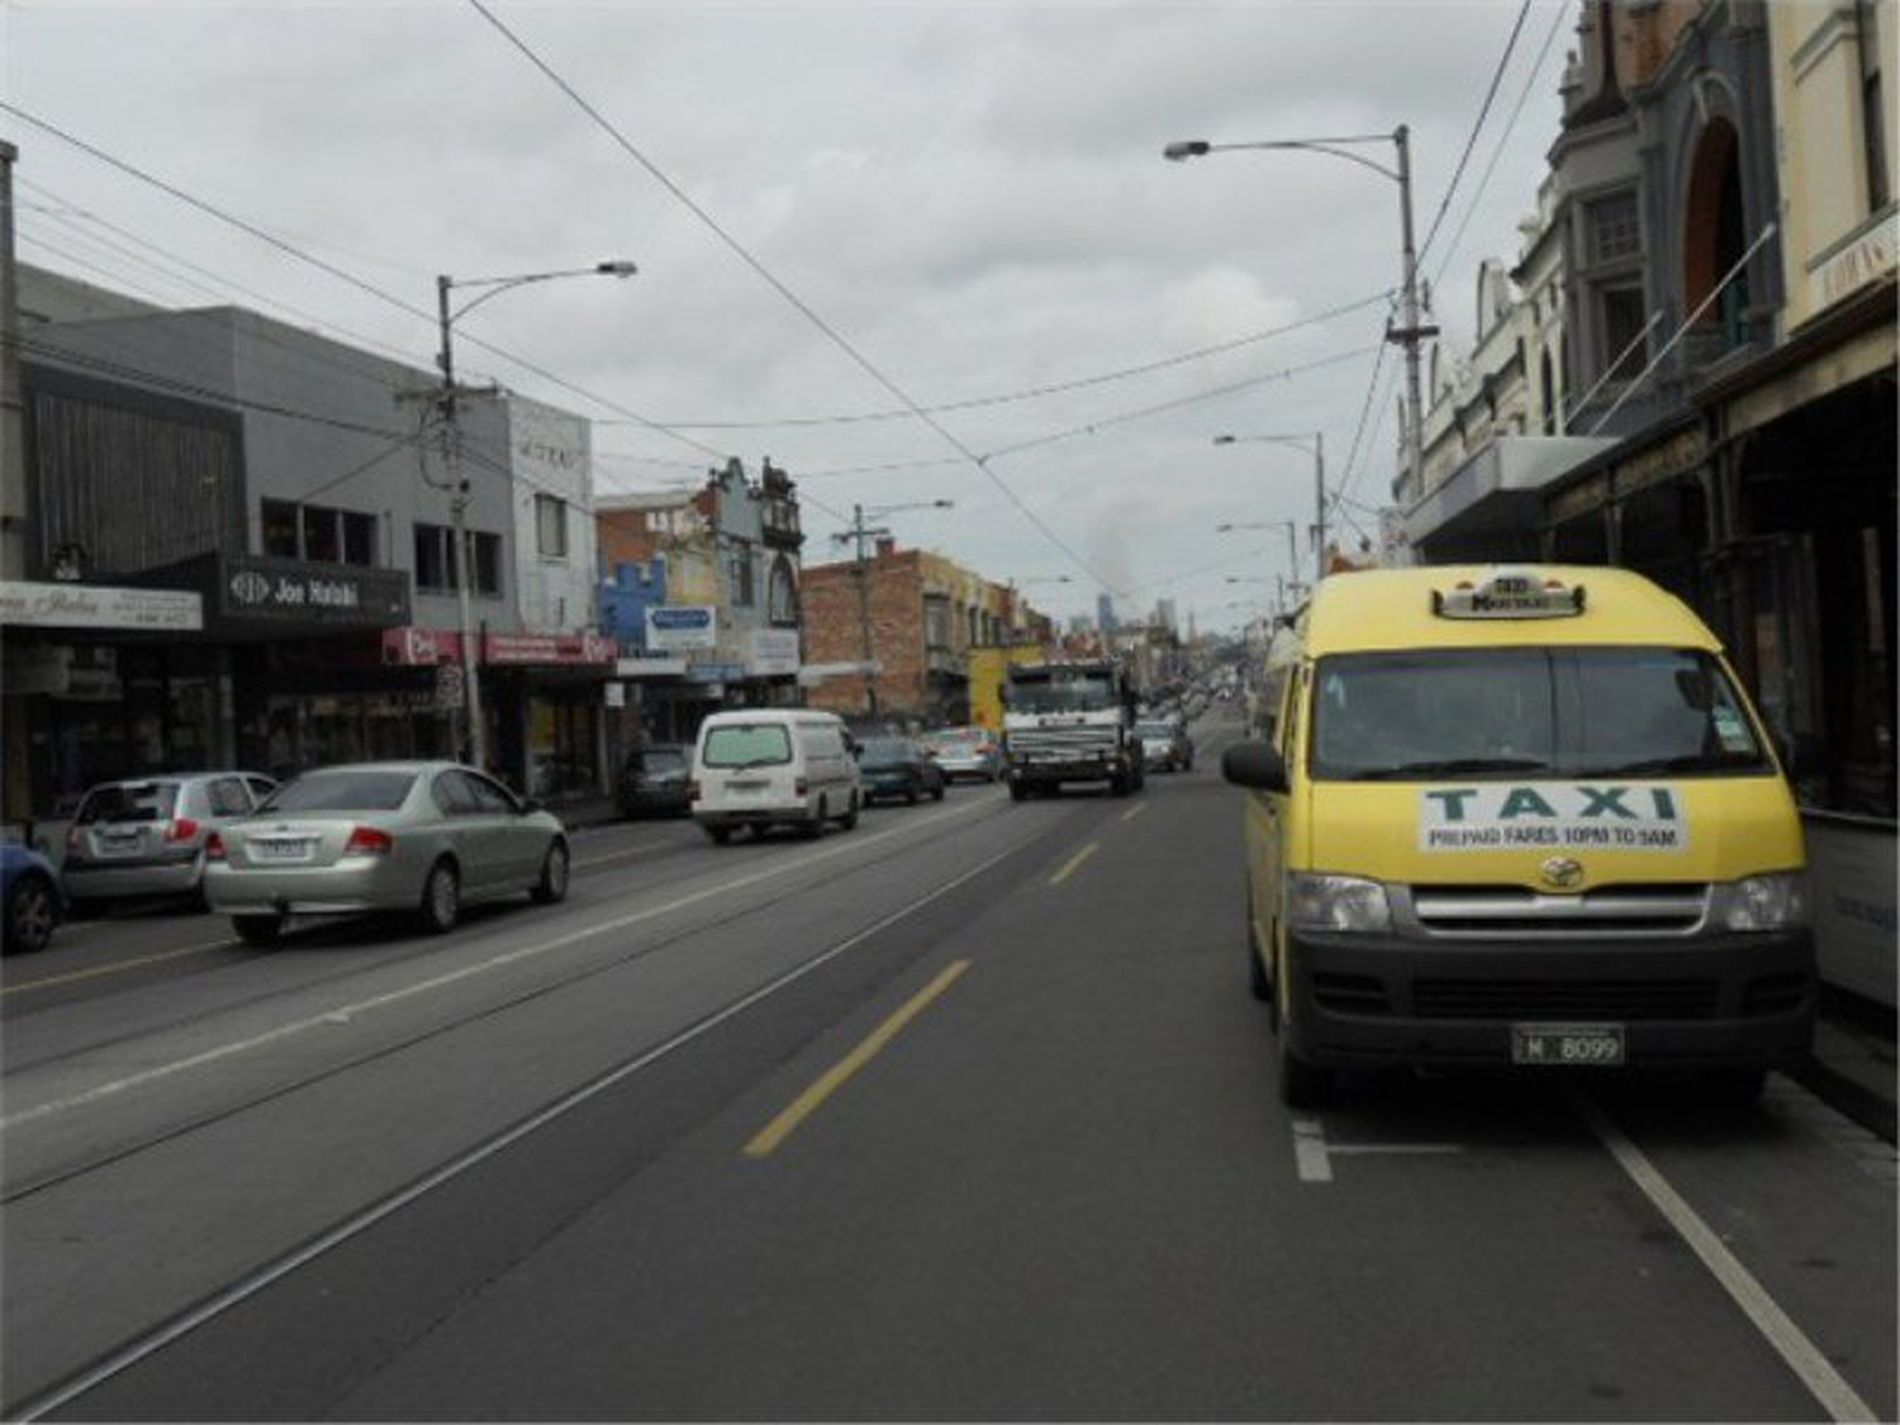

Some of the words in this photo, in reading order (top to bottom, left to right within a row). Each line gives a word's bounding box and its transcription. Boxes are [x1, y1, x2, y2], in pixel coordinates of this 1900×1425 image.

[274, 576, 305, 604] Joe
[1426, 787, 1677, 820] TAXI
[1430, 828, 1501, 847] PREPAID
[1504, 826, 1559, 844] FARES
[1566, 826, 1609, 844] 10PM
[1614, 827, 1636, 844] TO
[1562, 1036, 1618, 1058] 8099
